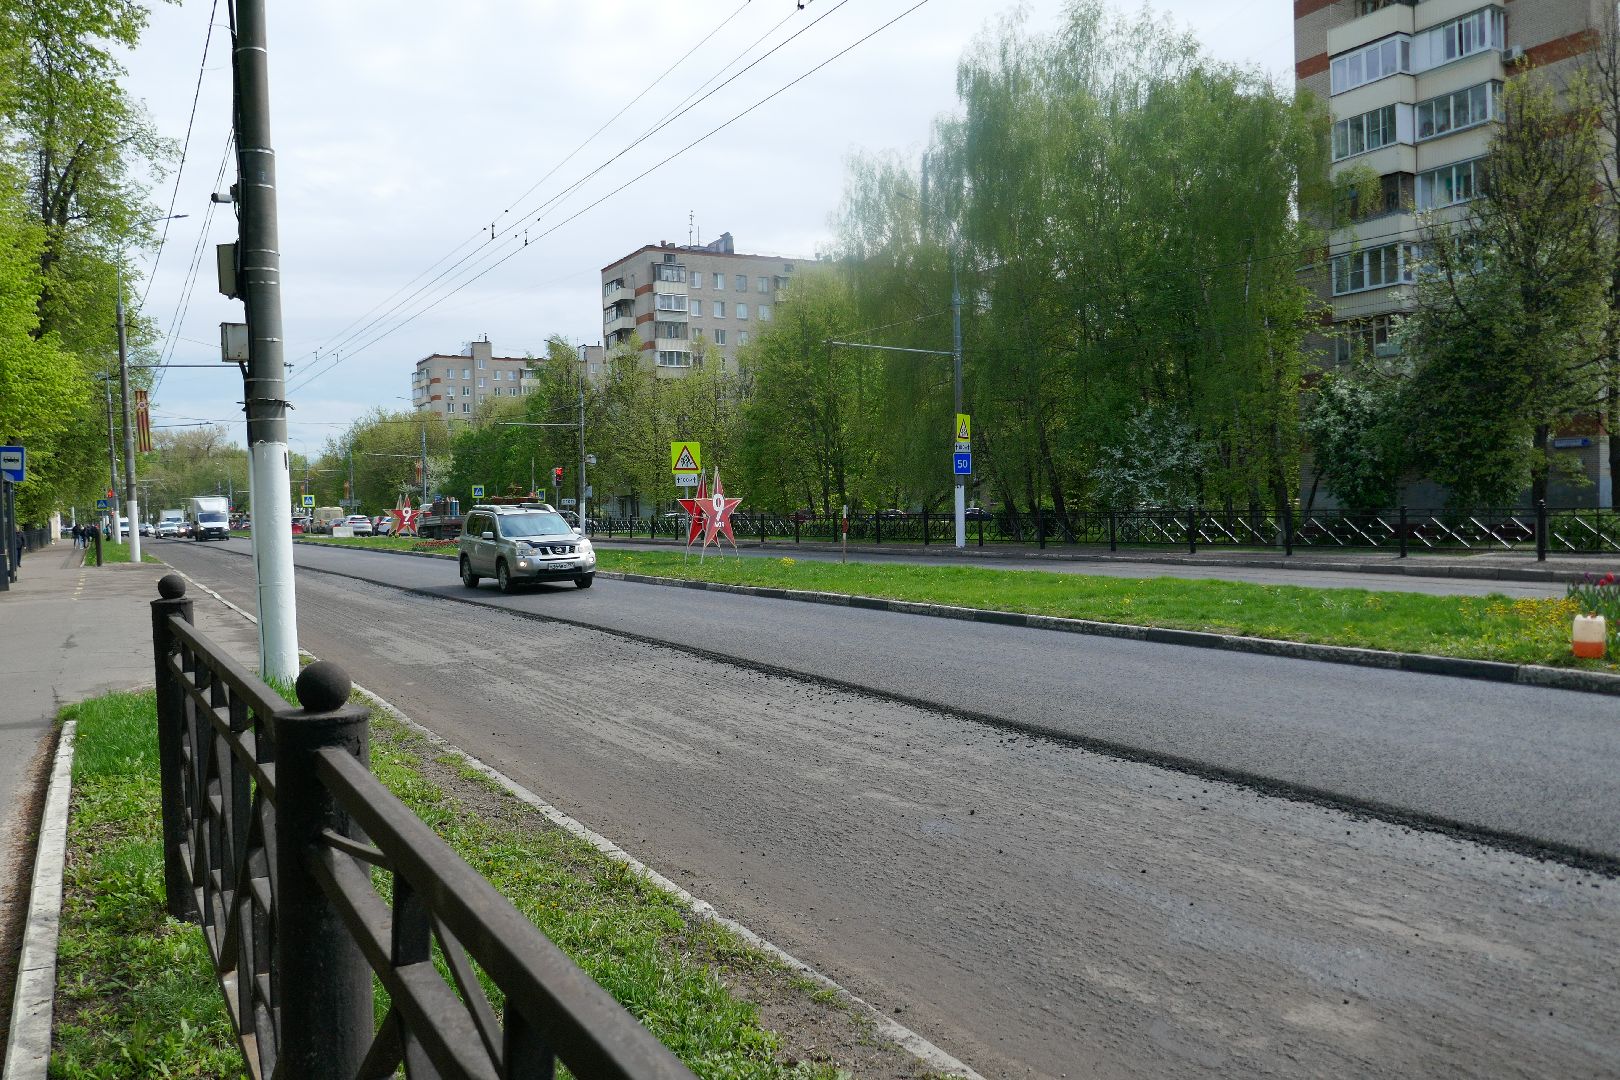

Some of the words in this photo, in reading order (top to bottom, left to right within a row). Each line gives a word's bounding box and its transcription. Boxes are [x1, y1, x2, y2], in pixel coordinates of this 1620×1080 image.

[957, 459, 968, 469] 50
[402, 506, 411, 522] 9
[713, 494, 724, 521] 9
